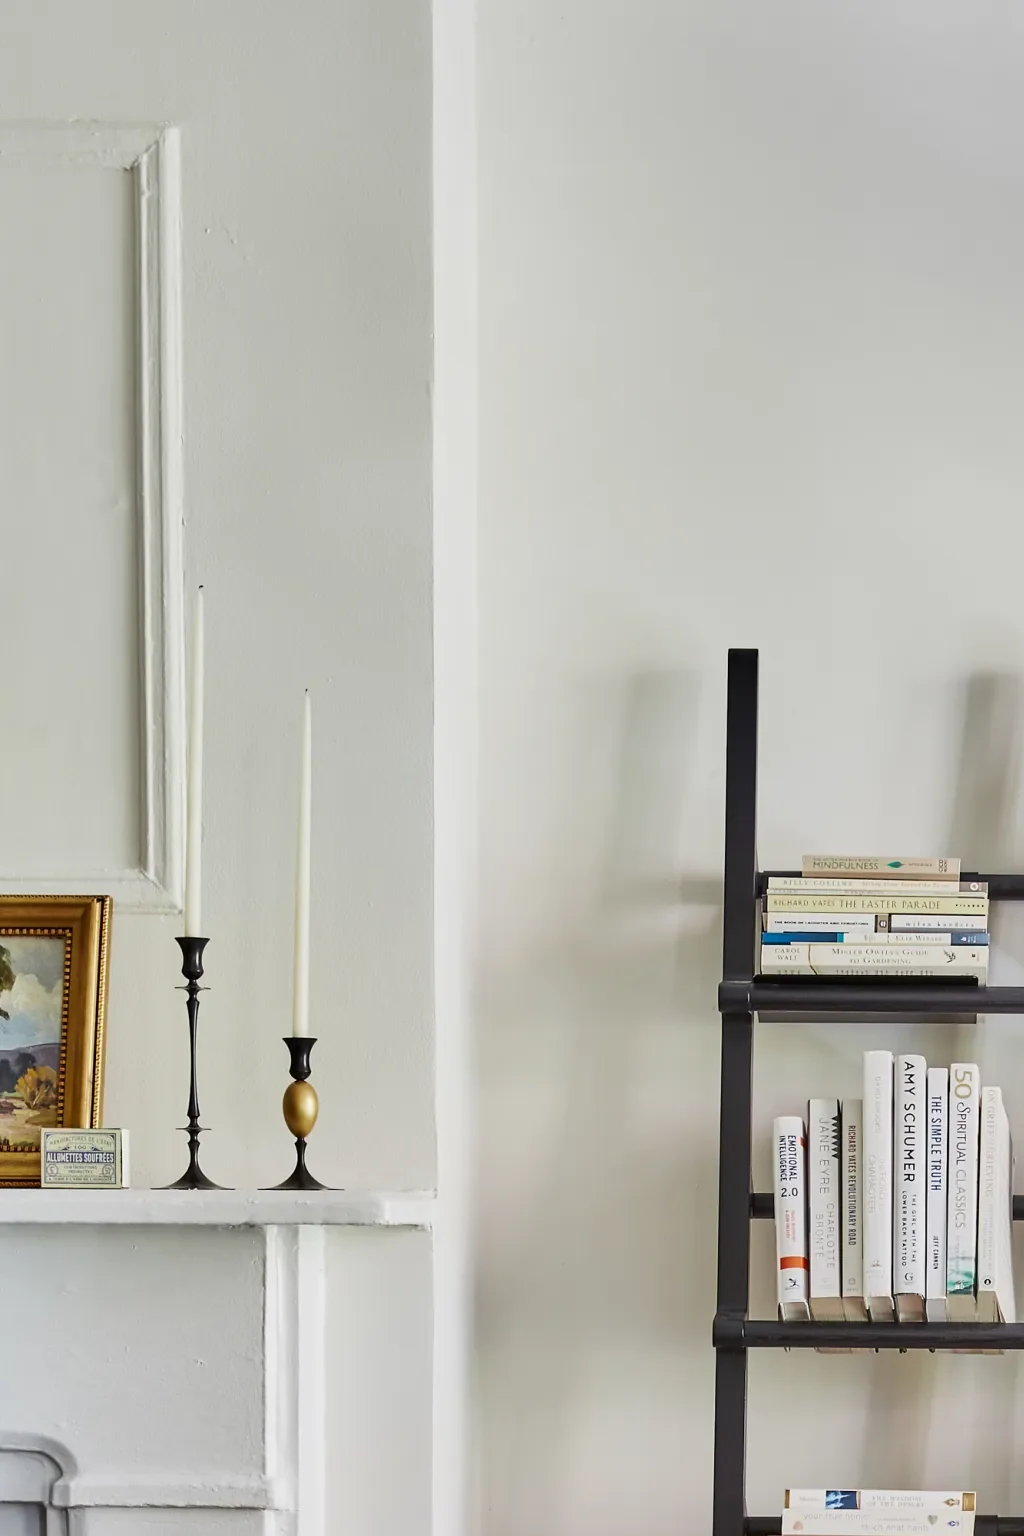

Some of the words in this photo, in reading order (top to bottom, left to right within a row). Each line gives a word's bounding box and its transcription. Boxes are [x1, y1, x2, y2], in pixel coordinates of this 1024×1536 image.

[813, 862, 878, 870] MINDFULNESS
[840, 899, 857, 908] THE
[862, 900, 897, 909] EASTER
[902, 900, 941, 909] PARADE
[904, 1061, 915, 1096] AMY
[955, 1068, 972, 1099] 50
[931, 1096, 942, 1114] THE
[848, 1125, 856, 1152] RICHARD
[903, 1104, 915, 1182] SCHUMER
[931, 1118, 941, 1154] SIMPLE
[956, 1102, 971, 1165] SPIRITUAL
[779, 1135, 787, 1182] INTELLIGENCE
[788, 1135, 797, 1181] EMOTIONAL
[848, 1154, 856, 1173] YATES
[931, 1159, 941, 1191] TRUTH
[781, 1187, 799, 1197] 2.0
[848, 1175, 856, 1227] REVOLUTIONARY
[955, 1170, 966, 1228] CLASSICS
[848, 1229, 856, 1245] ROAD
